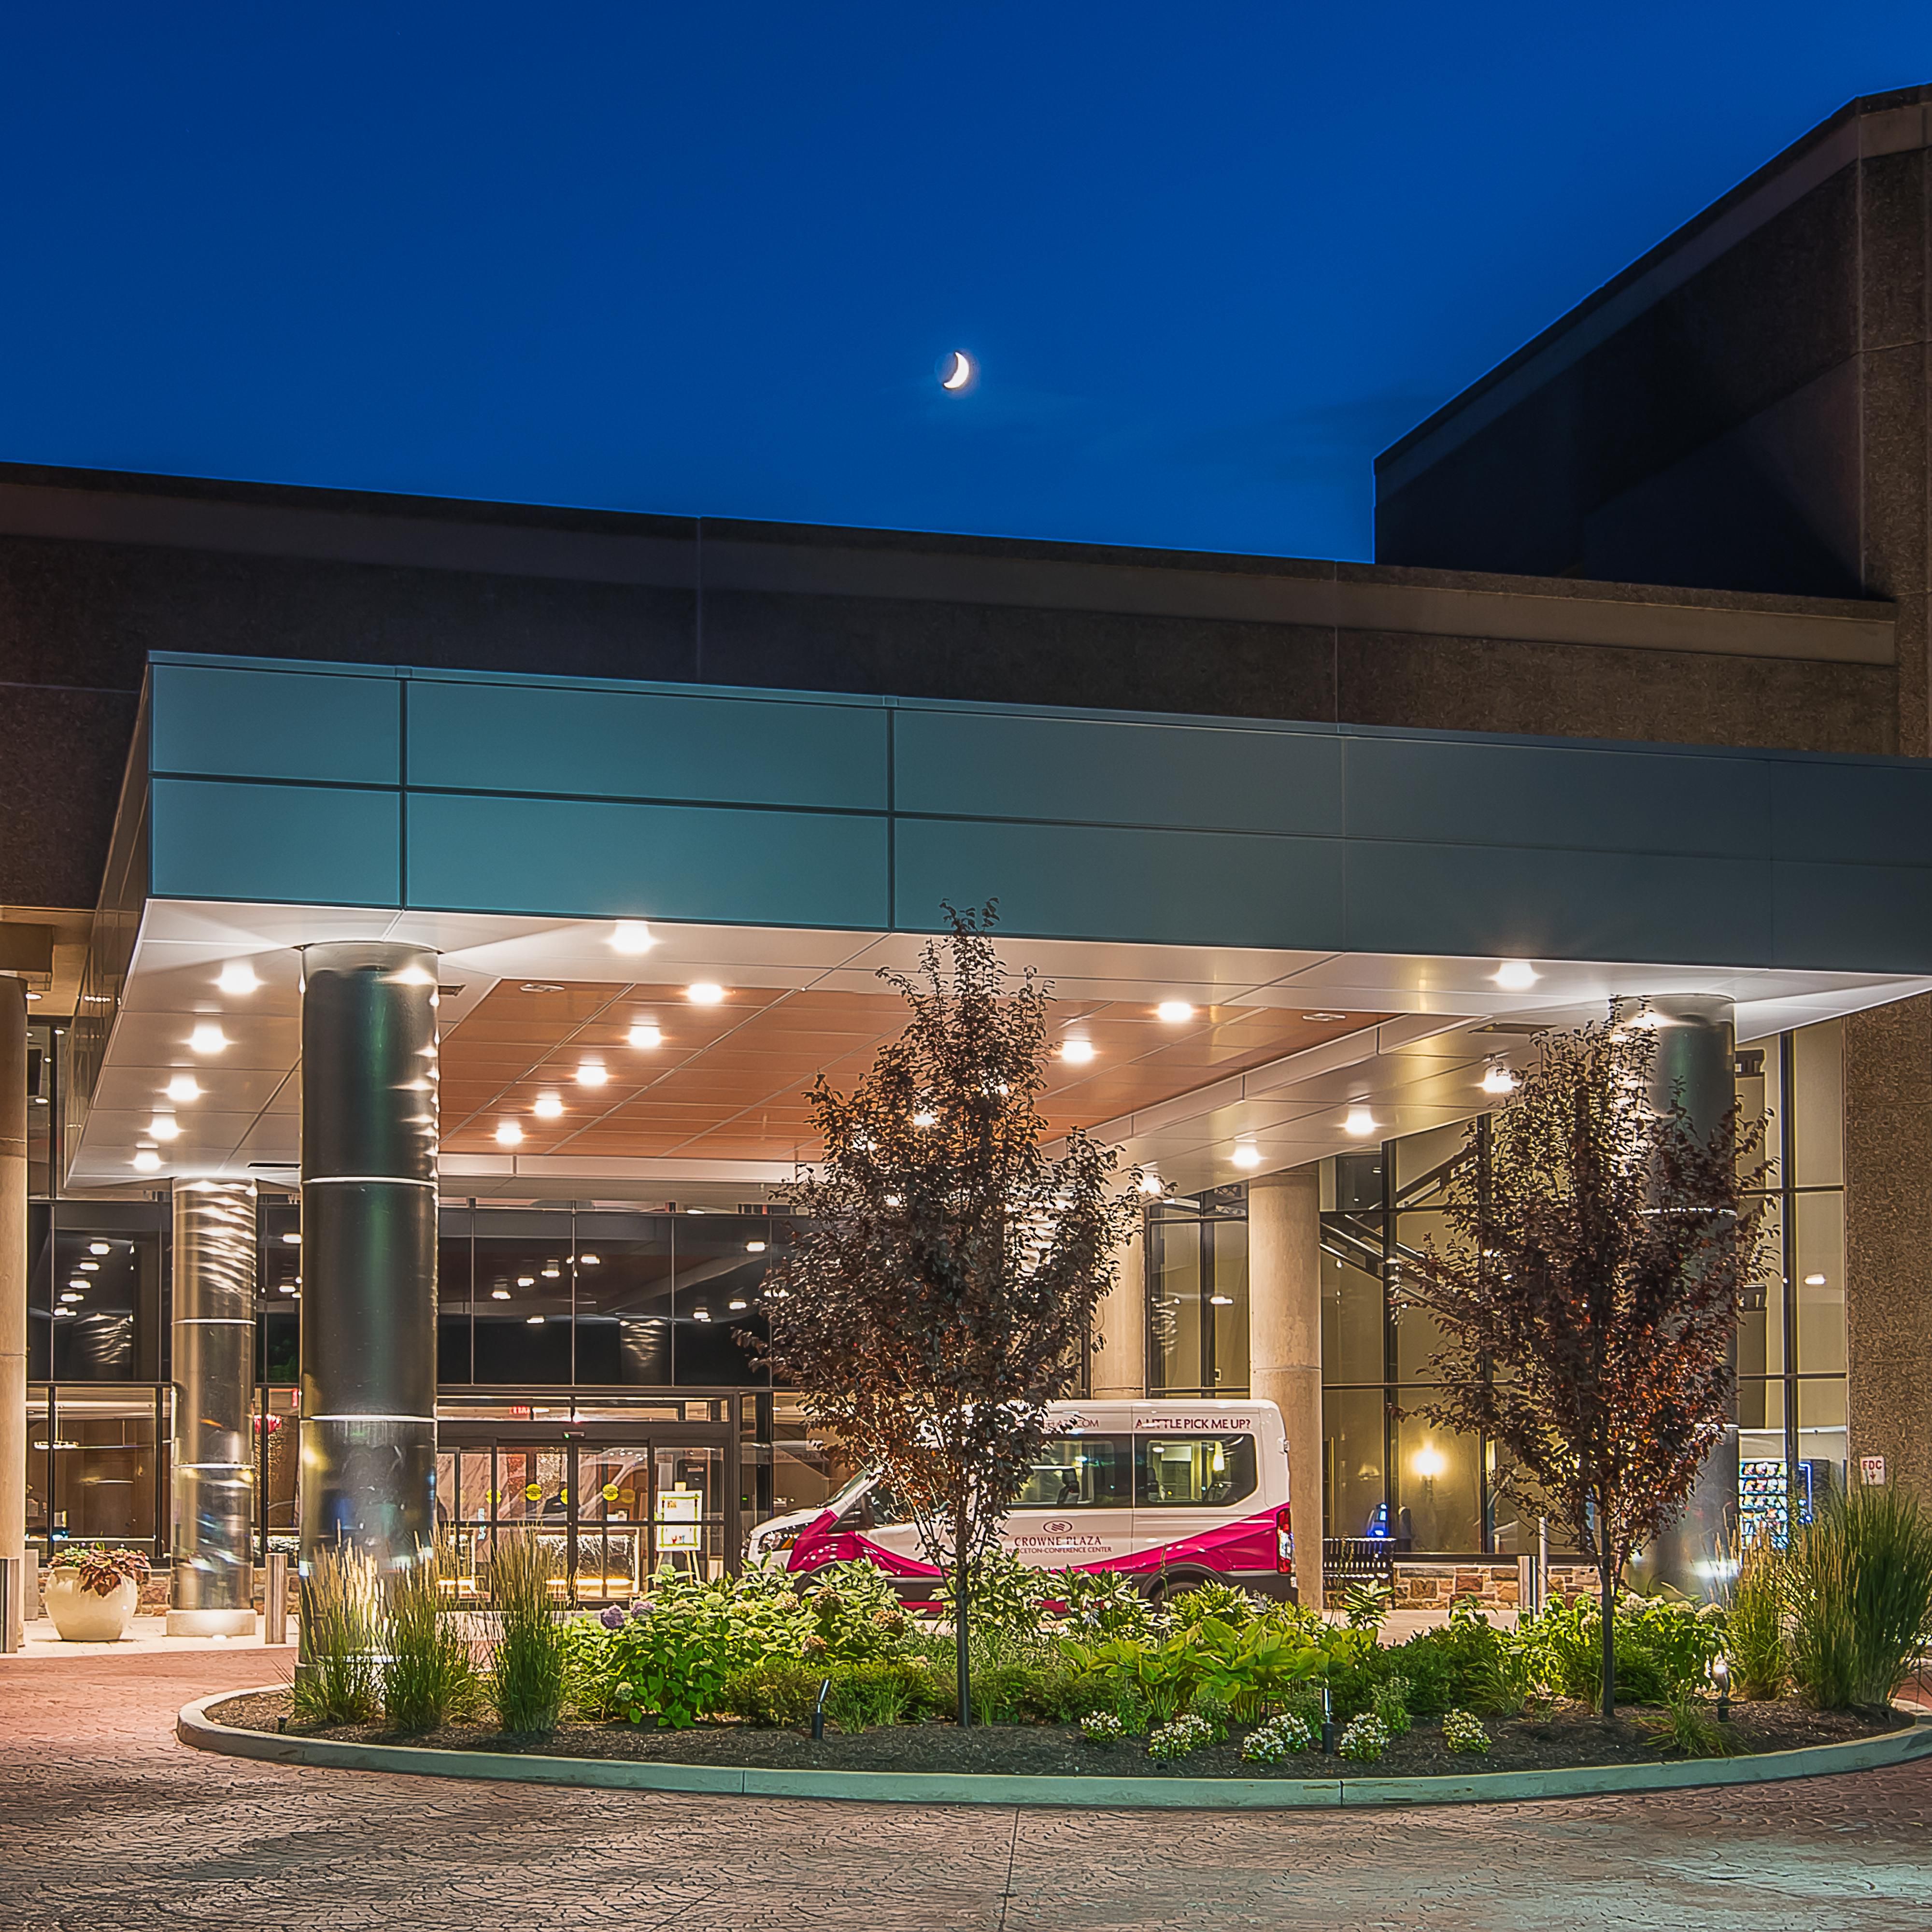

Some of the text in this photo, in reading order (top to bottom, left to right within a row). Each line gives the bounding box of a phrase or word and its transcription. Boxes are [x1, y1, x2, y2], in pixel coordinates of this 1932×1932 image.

[1136, 1419, 1251, 1429] A LITTLE PICK ME UP?
[1862, 1460, 1882, 1470] FDC
[1014, 1536, 1102, 1546] CROWNE PLAZA
